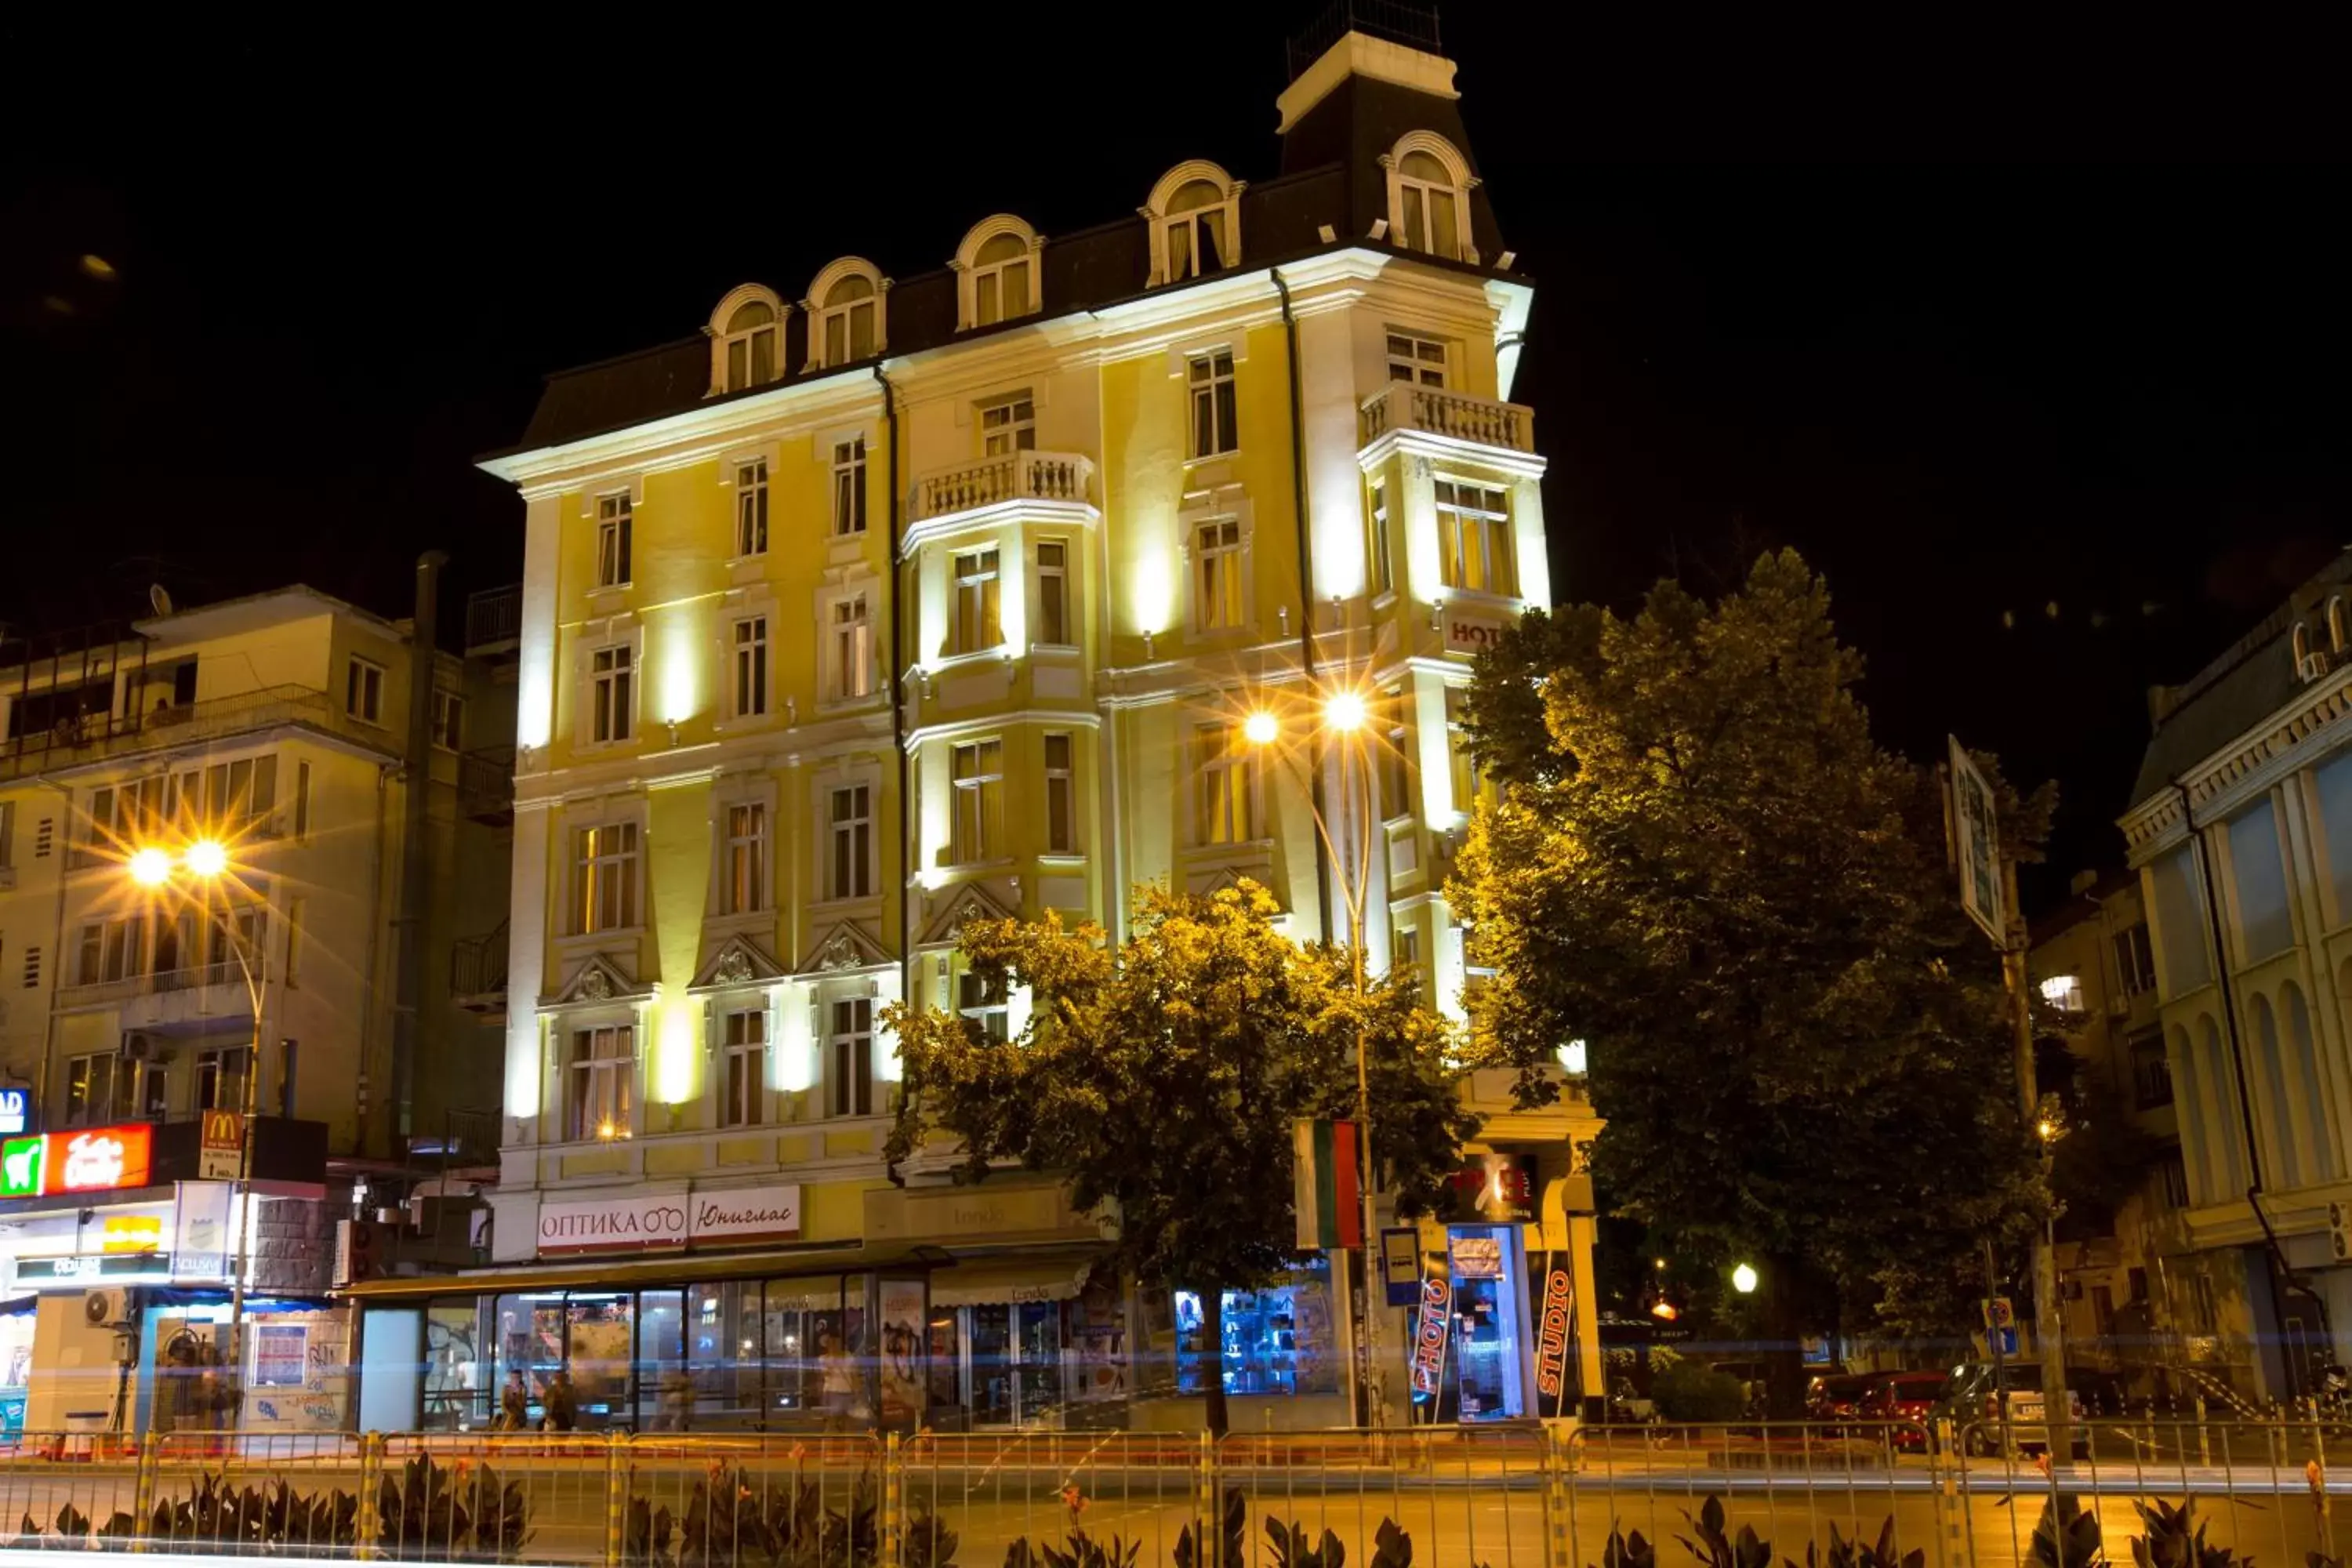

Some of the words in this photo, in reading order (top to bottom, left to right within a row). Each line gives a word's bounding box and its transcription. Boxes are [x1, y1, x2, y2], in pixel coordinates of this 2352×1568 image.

[1453, 622, 1500, 645] HOT
[541, 1211, 638, 1238] ОПТИКА
[695, 1200, 791, 1230] Юниглас
[1414, 1278, 1448, 1395] PHOTO
[1538, 1269, 1570, 1396] STUDIO
